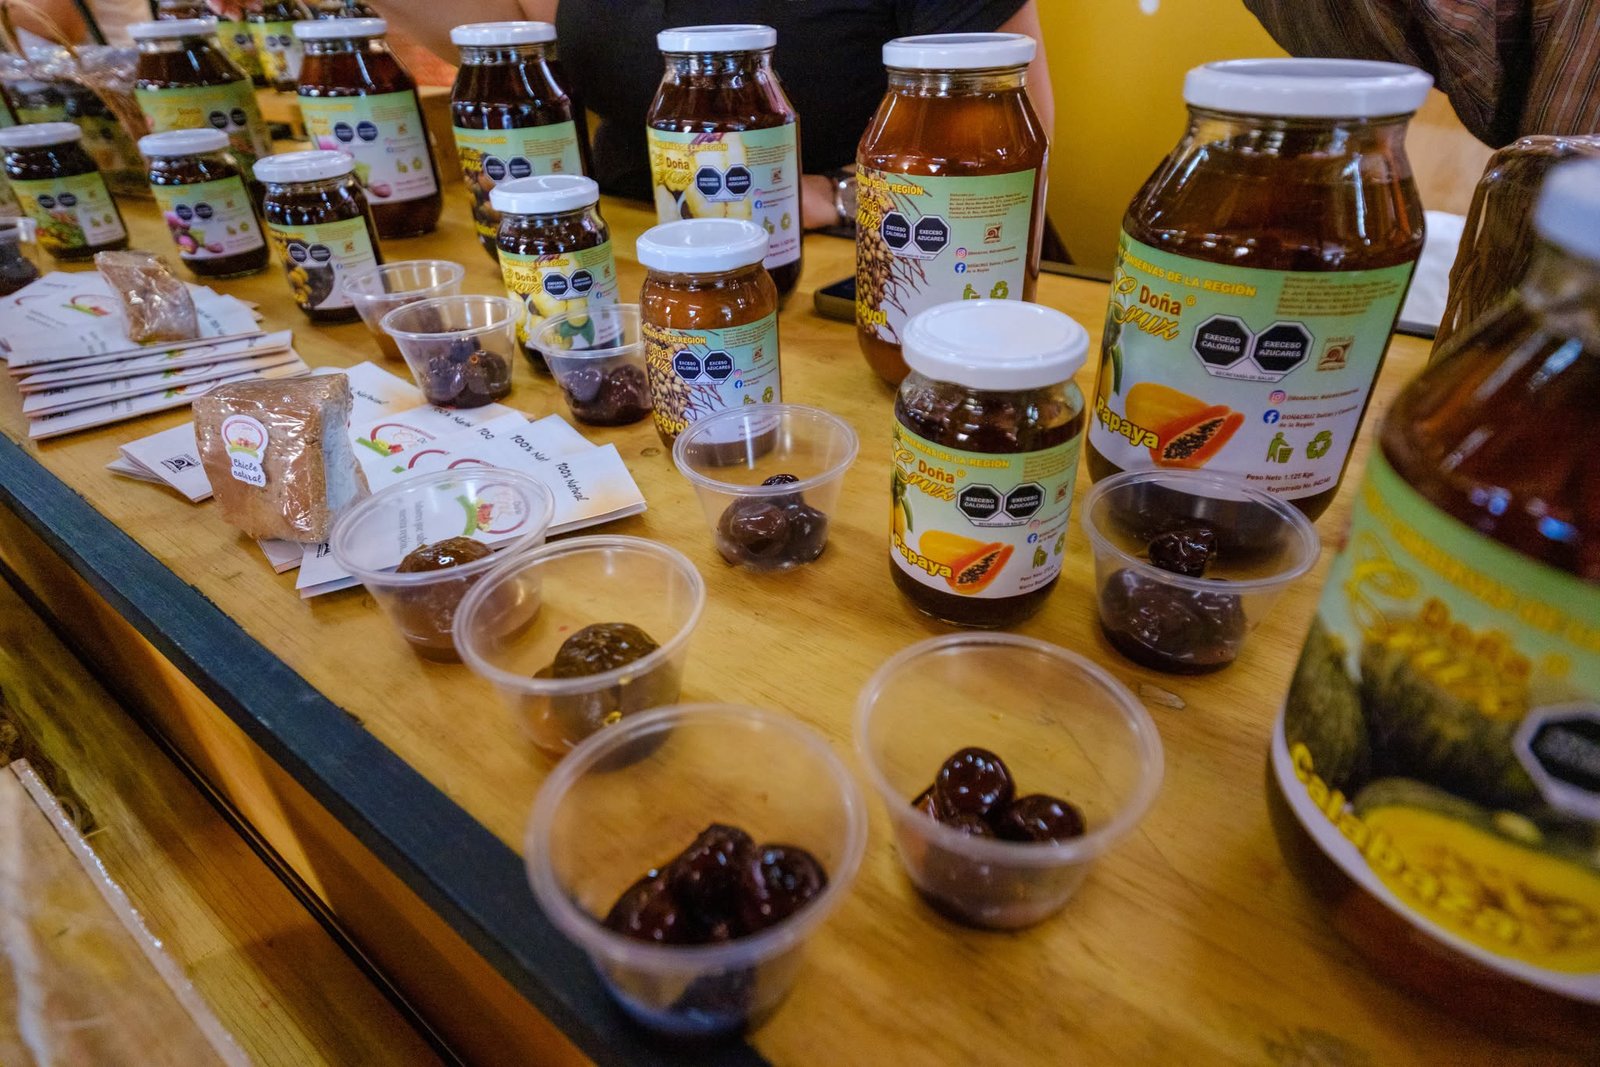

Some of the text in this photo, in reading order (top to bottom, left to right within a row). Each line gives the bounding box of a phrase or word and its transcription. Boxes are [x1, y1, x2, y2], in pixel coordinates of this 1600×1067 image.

[666, 156, 690, 170] Doña
[892, 184, 924, 195] REGIÓN
[1167, 271, 1182, 283] DE
[1184, 275, 1200, 287] LA
[1139, 283, 1183, 316] Doña
[1204, 333, 1242, 346] EXECESO
[1263, 341, 1302, 349] EXECESO
[1258, 349, 1302, 358] AZUCARES
[1096, 395, 1160, 450] Papaya
[477, 427, 495, 440] 100
[509, 434, 533, 453] 100%
[233, 459, 259, 472] Chicle
[918, 459, 956, 484] Doña
[233, 470, 262, 483] natural
[556, 462, 590, 502] 100% Natural
[1246, 473, 1264, 481] Peso
[1265, 473, 1282, 481] Neto
[893, 534, 954, 579] Papaya
[1290, 742, 1522, 946] Calabaza
